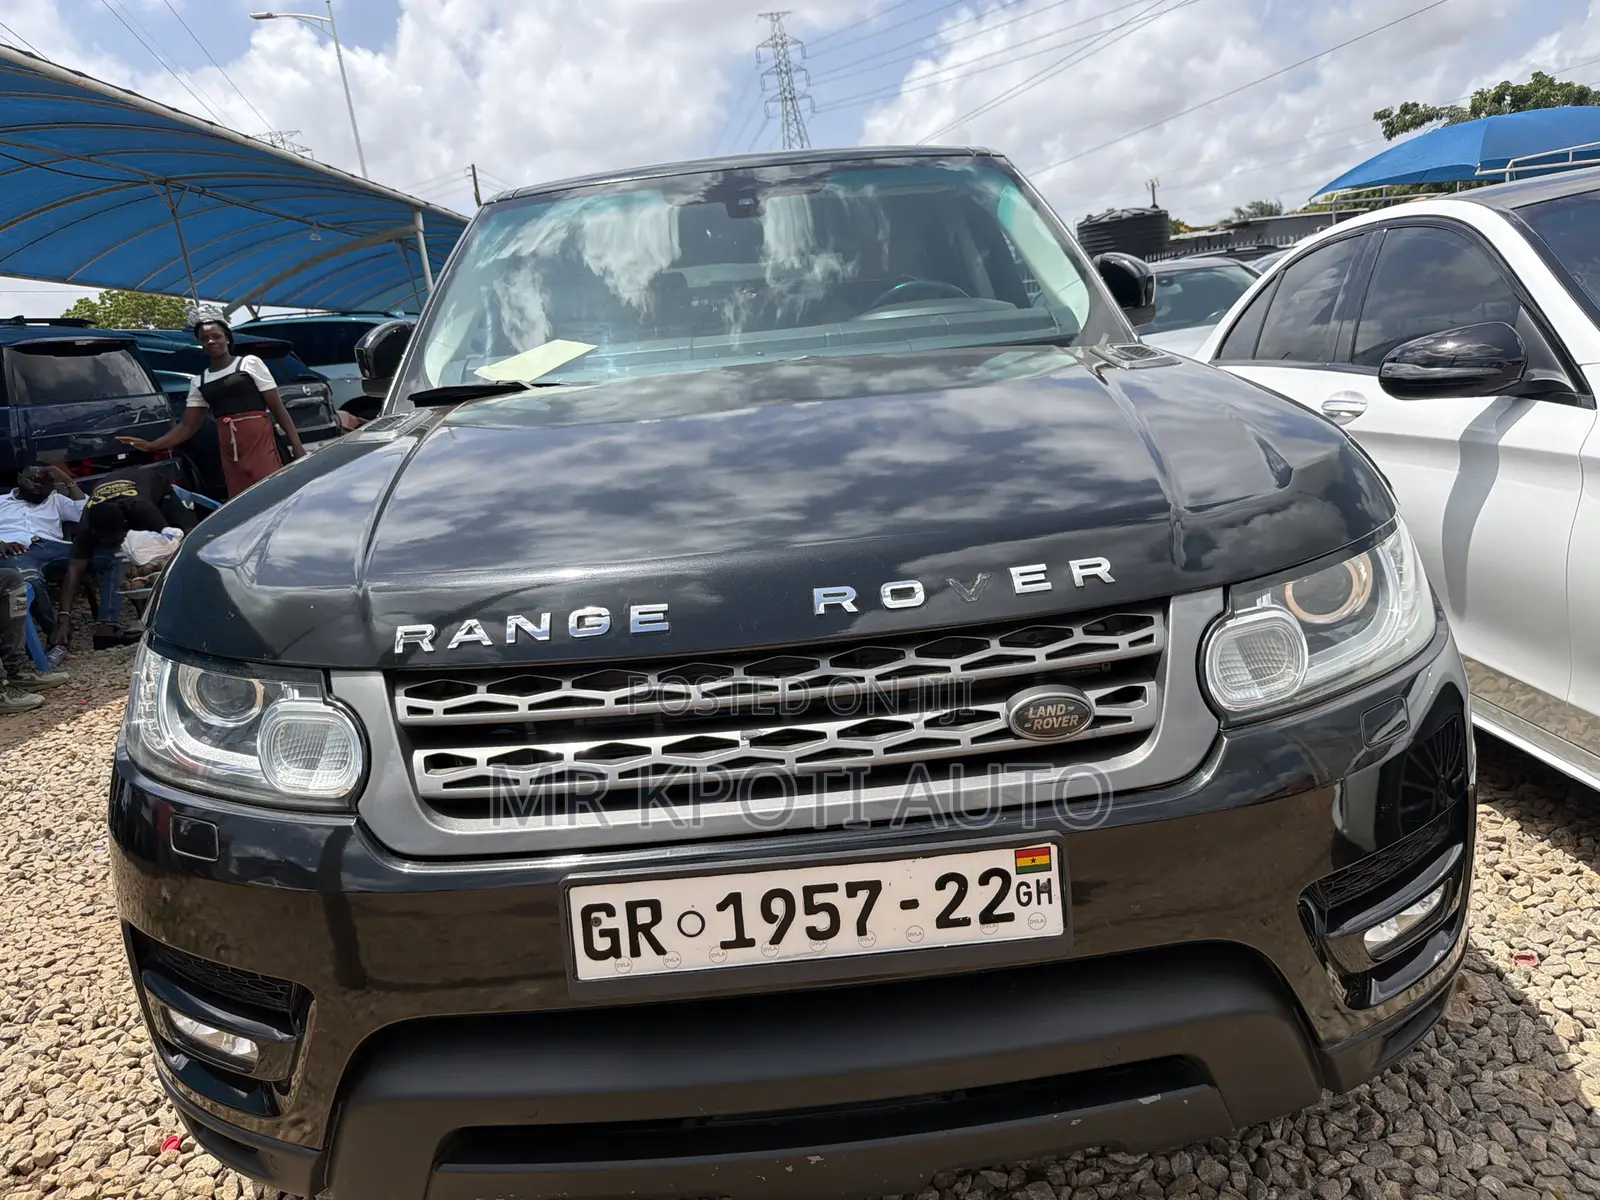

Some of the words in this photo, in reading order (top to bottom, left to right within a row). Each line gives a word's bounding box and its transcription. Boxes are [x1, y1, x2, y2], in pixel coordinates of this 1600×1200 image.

[394, 603, 669, 655] RANGE
[581, 899, 667, 961] GR
[716, 880, 882, 950] 1957
[935, 867, 1015, 929] 22
[1015, 877, 1052, 907] GH
